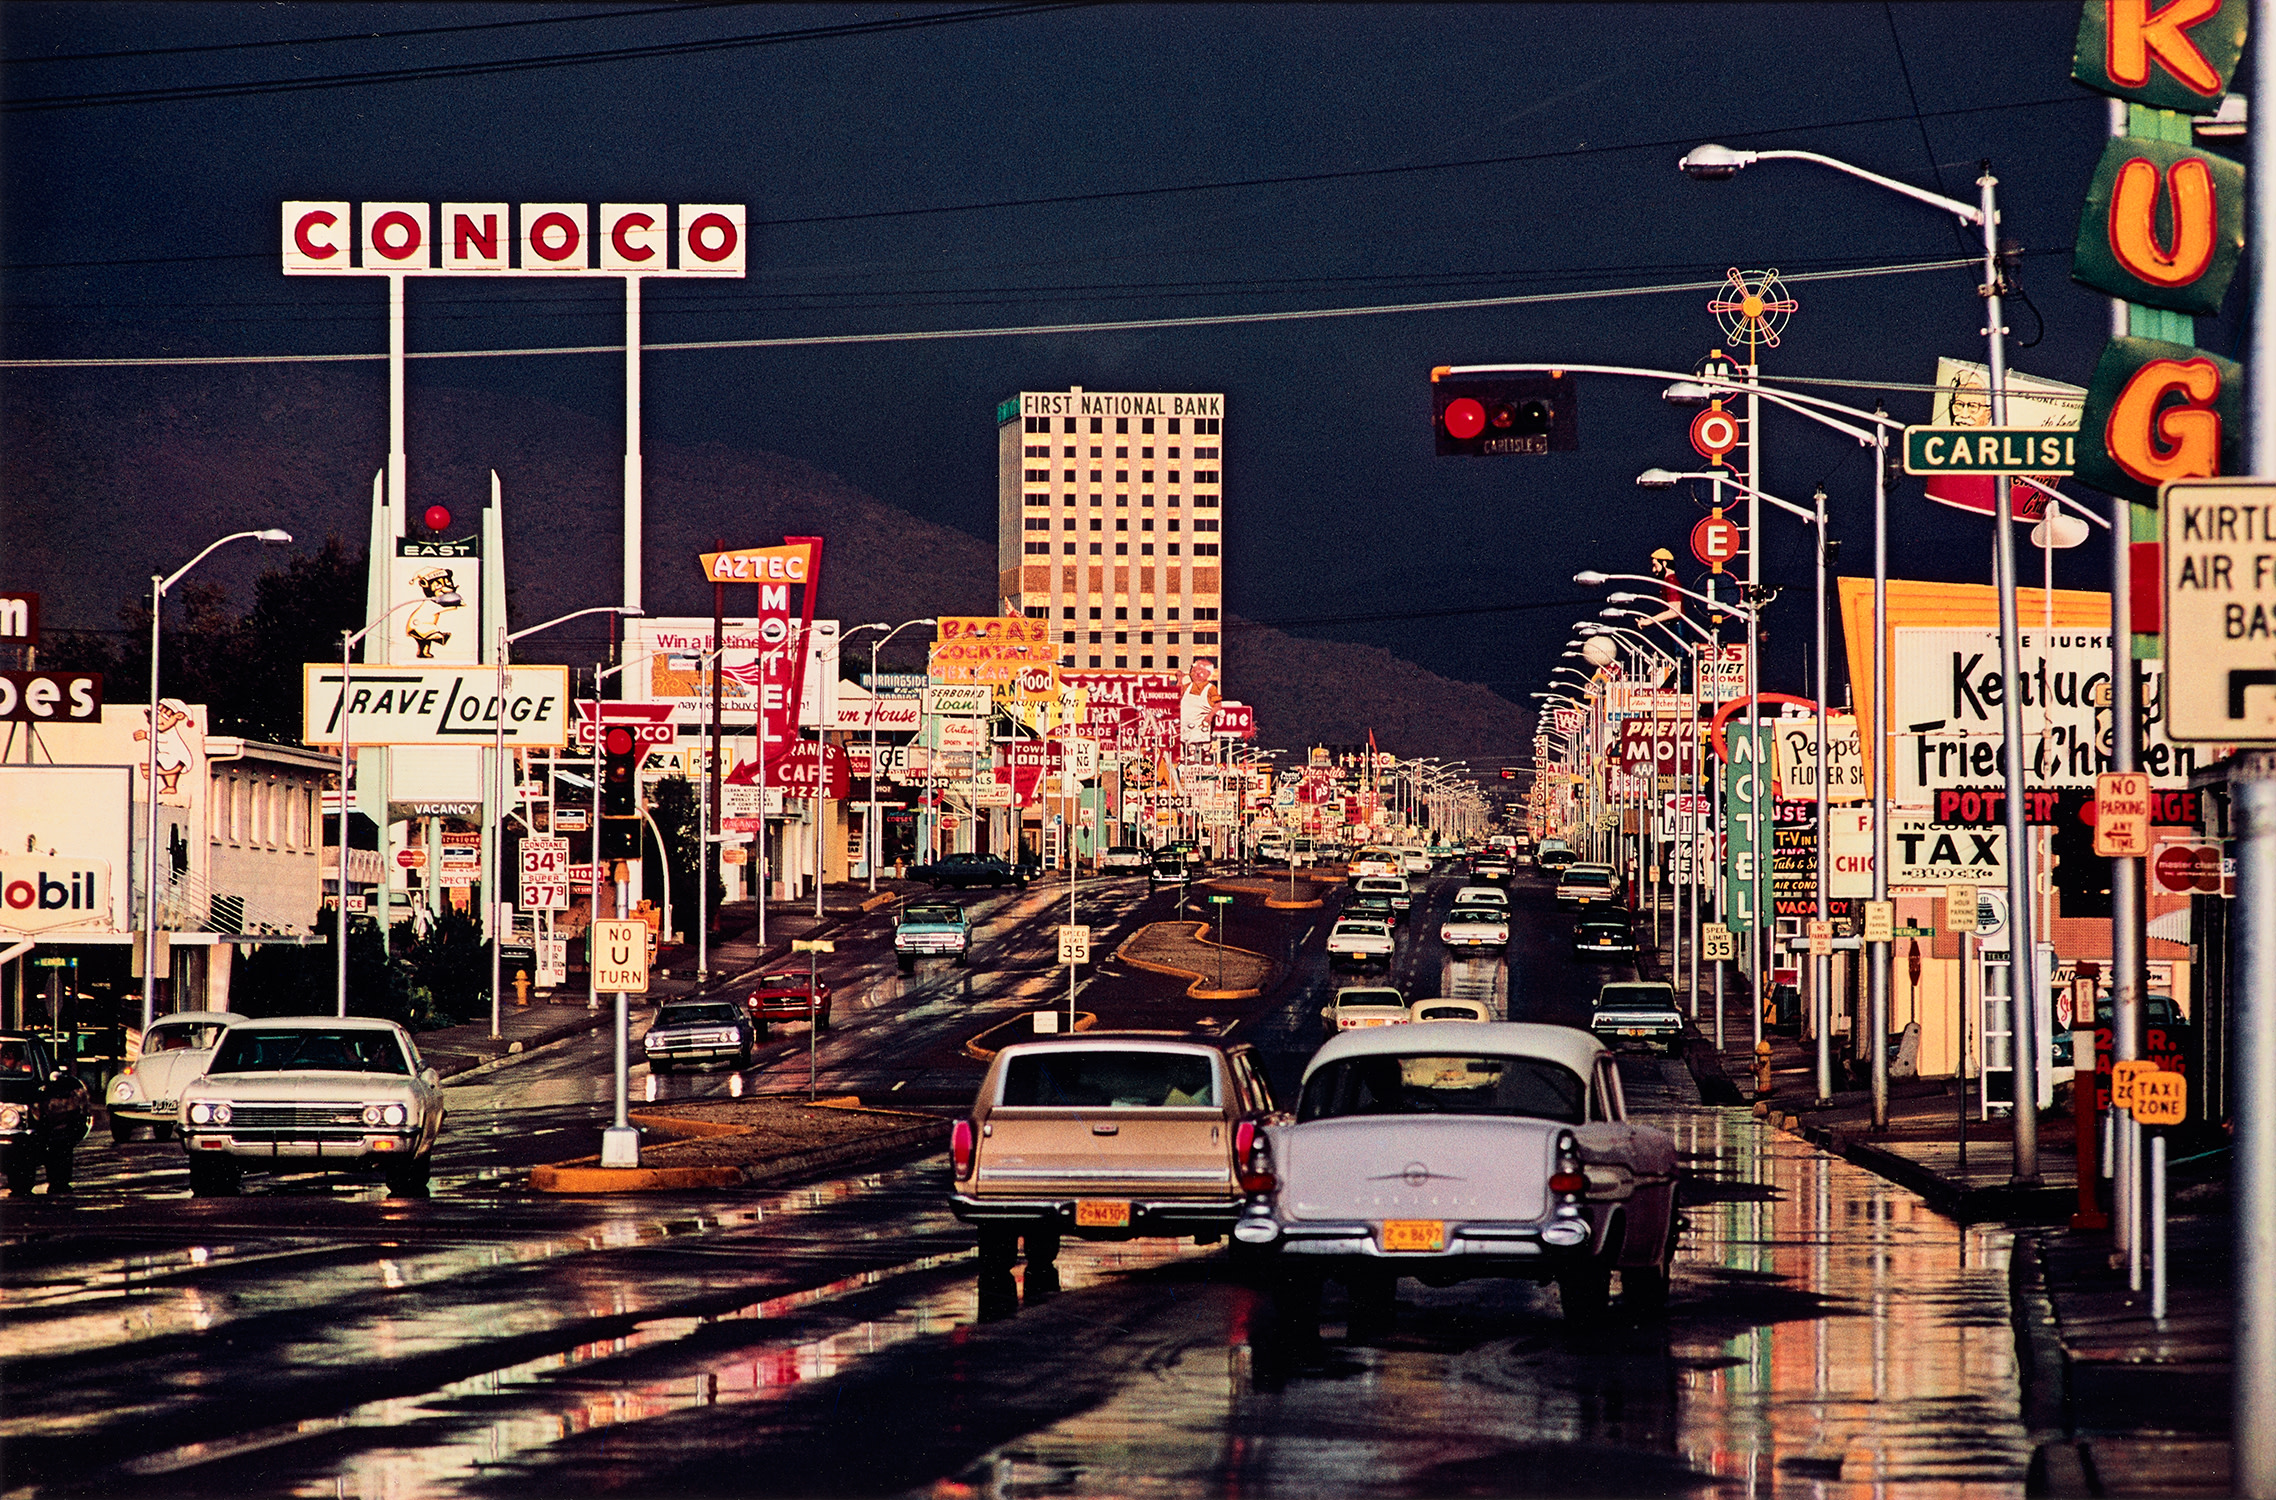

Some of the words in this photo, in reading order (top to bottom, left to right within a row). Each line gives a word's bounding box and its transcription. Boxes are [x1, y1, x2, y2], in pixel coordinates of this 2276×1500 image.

[294, 210, 738, 262] CONOCO
[1025, 396, 1072, 414] FIRST
[1082, 396, 1166, 415] NATIONAL
[1174, 397, 1220, 416] BANK
[404, 546, 470, 556] EAST
[714, 554, 804, 580] AZTEC
[2178, 554, 2232, 590] AIR
[942, 620, 1046, 642] BACA'S
[657, 634, 688, 648] Win
[691, 638, 701, 648] a
[705, 634, 760, 648] lietime
[1996, 636, 2030, 648] TE
[937, 645, 1053, 660] COCKTAILS
[761, 585, 787, 742] MOTEL
[932, 665, 1009, 680] MEXCAN
[862, 675, 928, 688] MRNINGSIDE
[864, 701, 917, 726] House
[582, 724, 670, 741] COCO
[1007, 754, 1061, 766] LODGE
[778, 763, 834, 783] CAFE
[1792, 766, 1844, 785] FLOER
[2112, 780, 2136, 796] NO
[414, 804, 478, 816] VACANCY
[2100, 800, 2145, 815] PARKING
[1734, 734, 1767, 919] MOTEL
[1896, 834, 2001, 866] TAX
[1911, 868, 1984, 879] BLOCK
[0, 872, 94, 910] obil
[1774, 881, 1790, 890] AIR
[1776, 901, 1848, 915] VACACY
[610, 928, 632, 942] NO
[612, 946, 629, 965] U
[1706, 942, 1730, 956] 35
[599, 970, 642, 984] TURN
[2139, 1082, 2180, 1096] TAXI
[2138, 1100, 2180, 1114] ZONE
